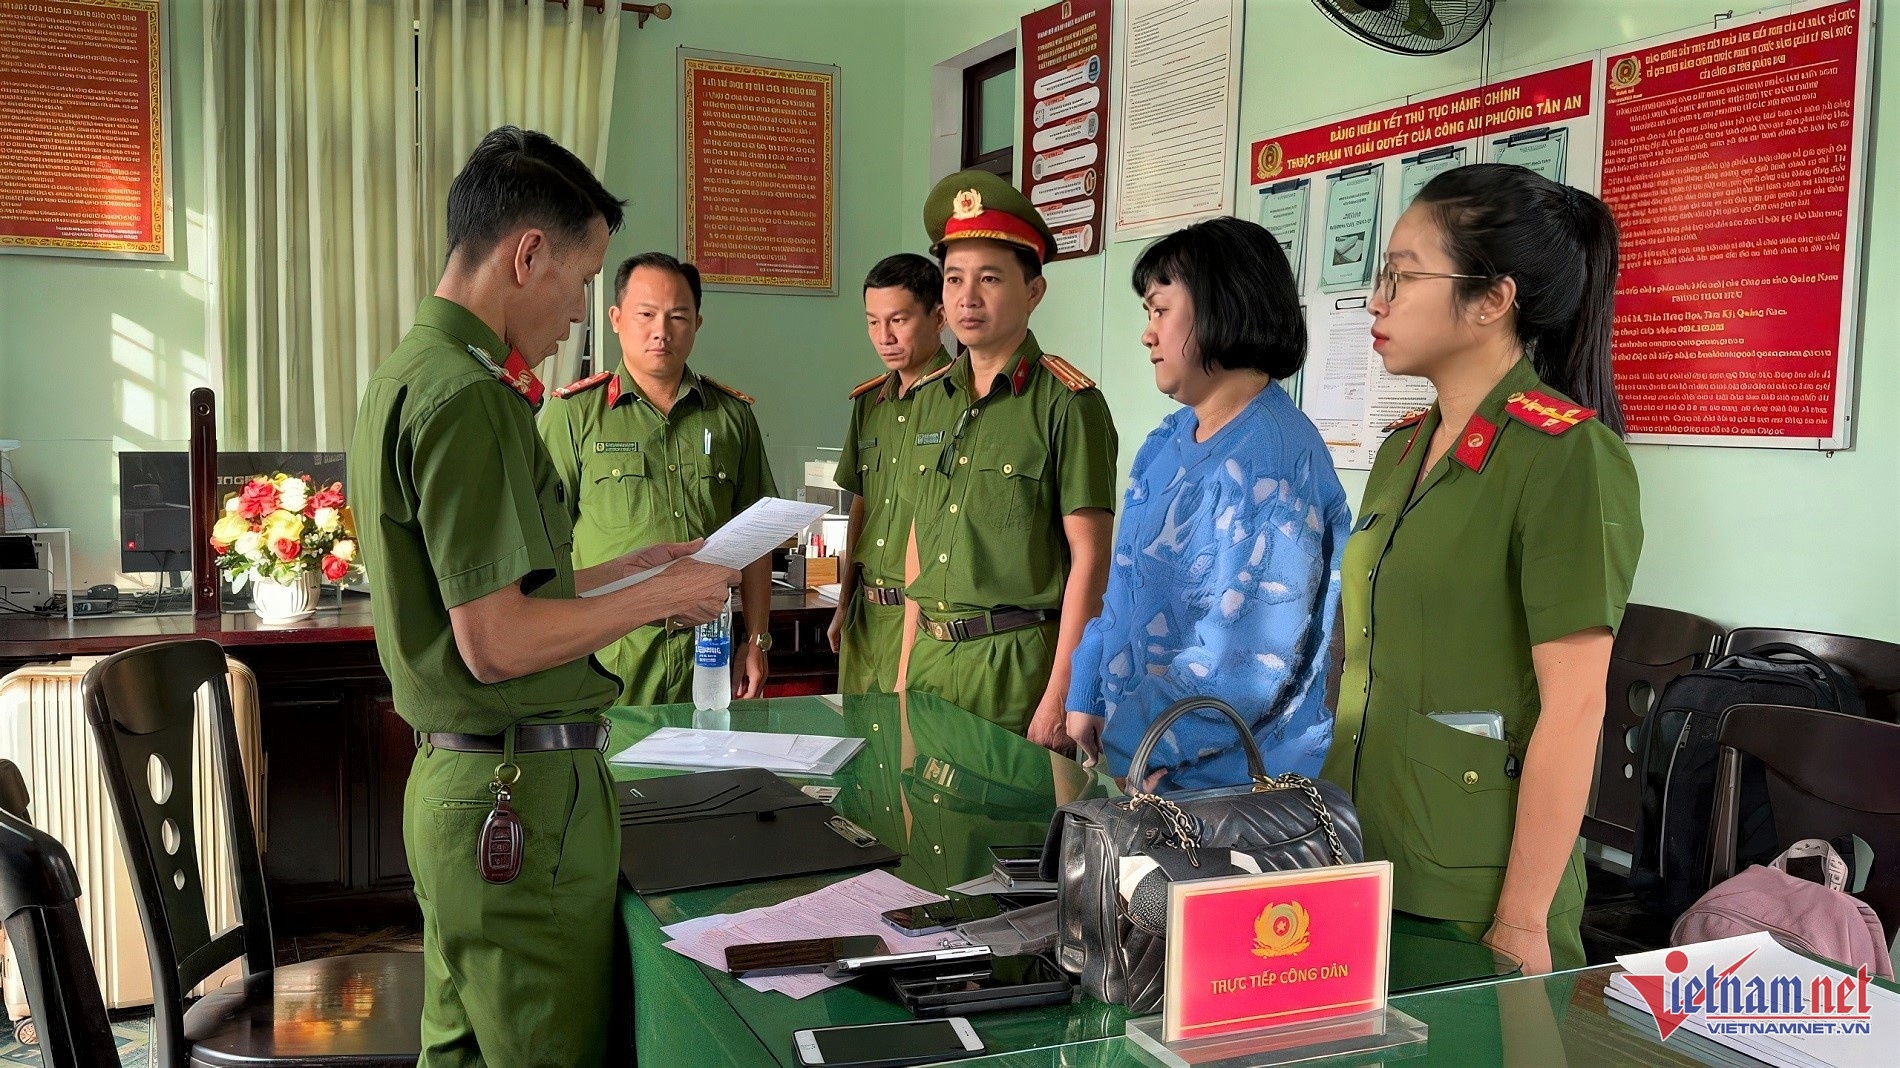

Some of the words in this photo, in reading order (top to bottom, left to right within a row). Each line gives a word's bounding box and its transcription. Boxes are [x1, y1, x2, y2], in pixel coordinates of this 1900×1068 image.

[1354, 137, 1375, 155] GIẢI
[1376, 129, 1409, 151] QUYẾT
[1411, 125, 1432, 144] CỦA
[1434, 119, 1464, 138] CÔNG
[1466, 115, 1483, 131] AN
[1485, 105, 1533, 127] PHƯỜNG
[1536, 98, 1561, 116] TÂN
[1563, 94, 1582, 111] AN
[1383, 111, 1402, 130] YẾT
[1405, 105, 1425, 124] THỦ
[1427, 103, 1449, 121] TỤC
[1451, 93, 1481, 115] HÀNH
[1484, 86, 1521, 106] CHÍNH
[1211, 976, 1247, 995] TRỰC
[1249, 968, 1277, 989] TIẾP
[1279, 965, 1318, 984] CÔNG
[1320, 962, 1349, 979] DÂN
